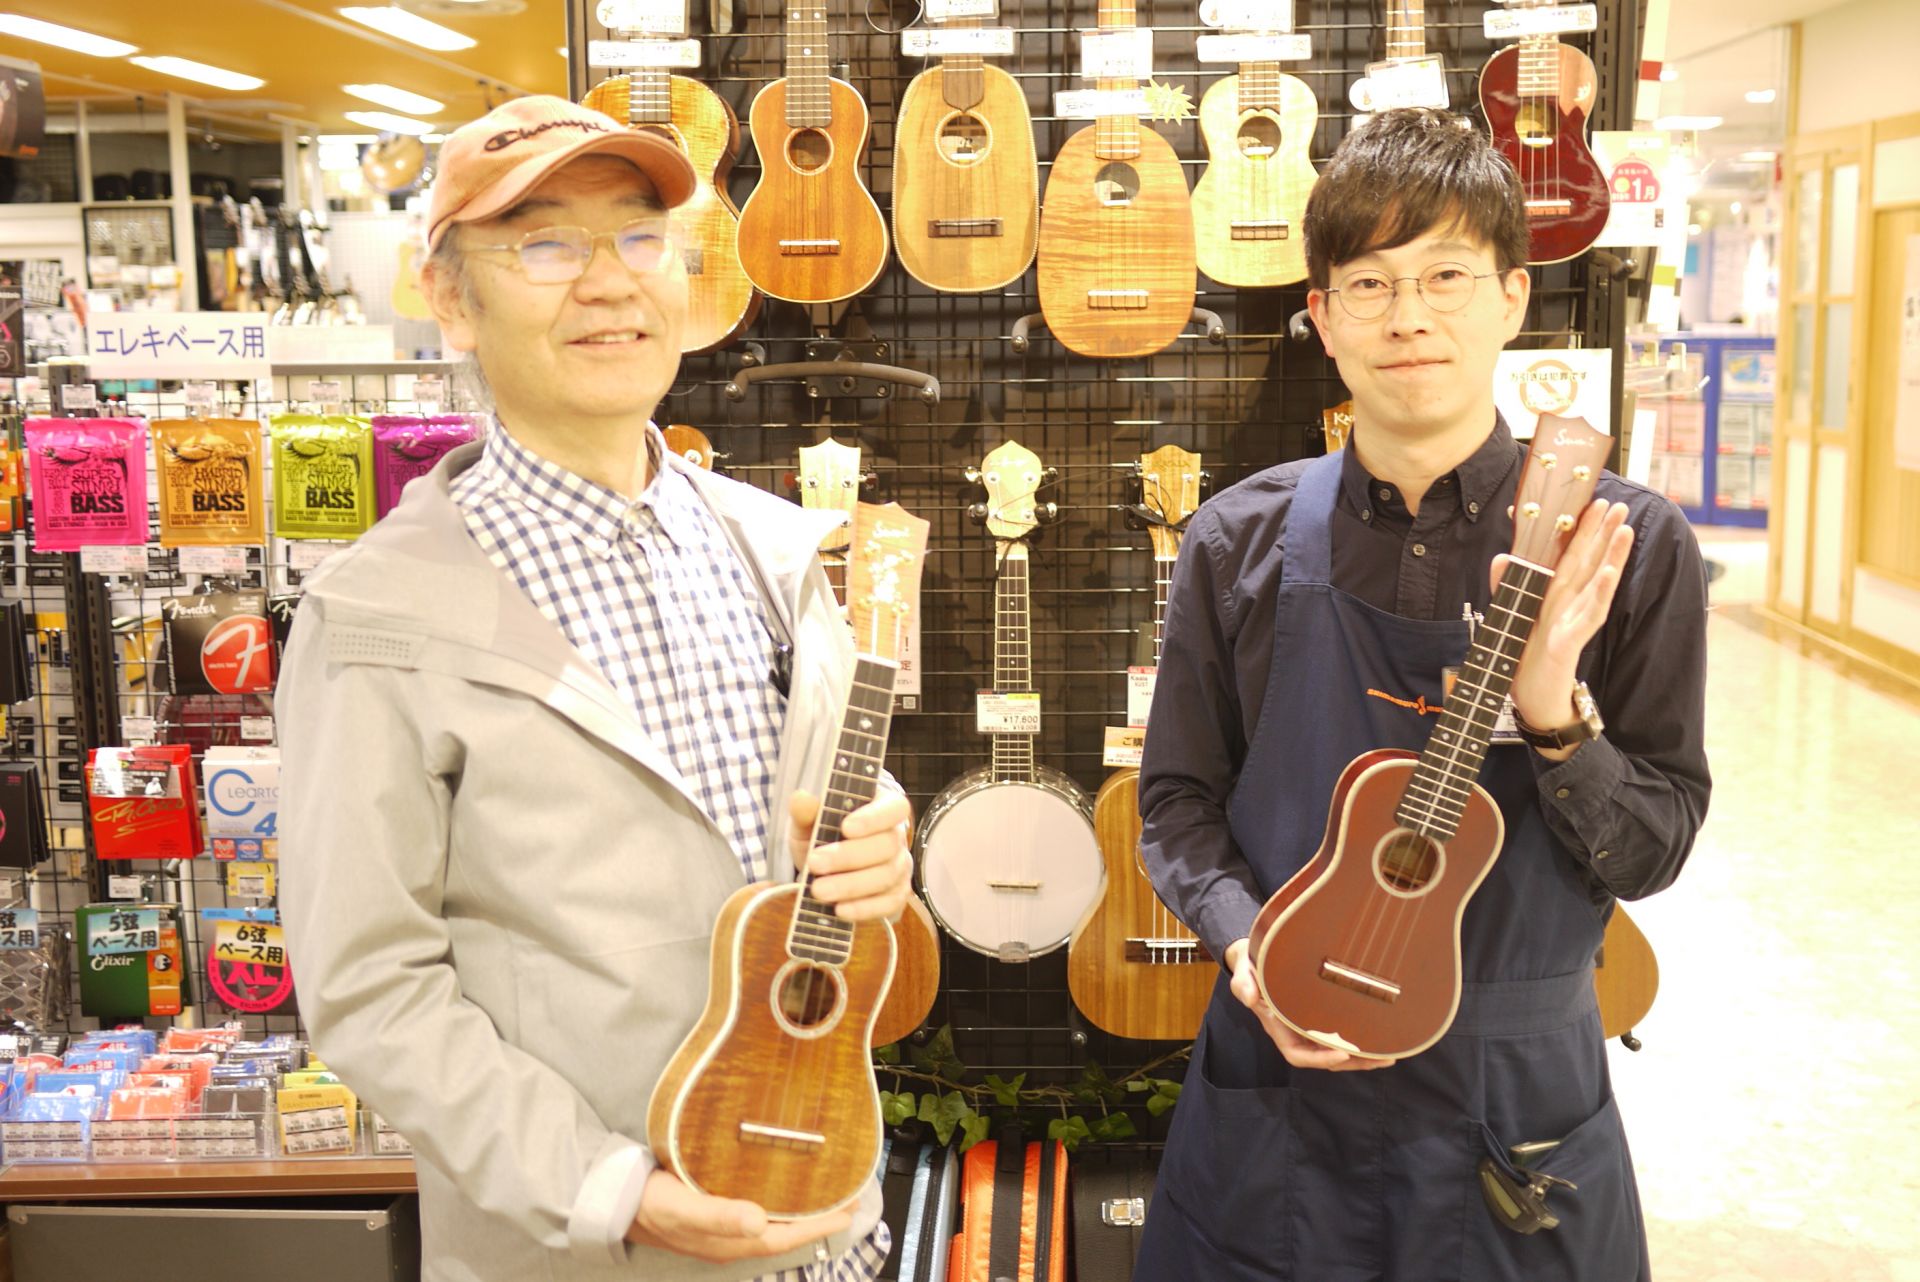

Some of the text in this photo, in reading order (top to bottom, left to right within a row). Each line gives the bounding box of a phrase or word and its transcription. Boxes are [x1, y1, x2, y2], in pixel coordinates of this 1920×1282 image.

[95, 326, 265, 358] エレキベース用
[73, 468, 121, 480] SUPER
[194, 466, 243, 479] HYBRID
[70, 495, 124, 514] BASS
[193, 494, 245, 512] BASS
[305, 490, 354, 509] BASS
[163, 597, 217, 620] Fender
[253, 812, 277, 837] 4
[109, 912, 140, 932] 5弦
[93, 929, 157, 949] ベース用
[236, 925, 268, 943] 6弦
[90, 954, 136, 971] Elixir
[217, 943, 284, 964] ベース用
